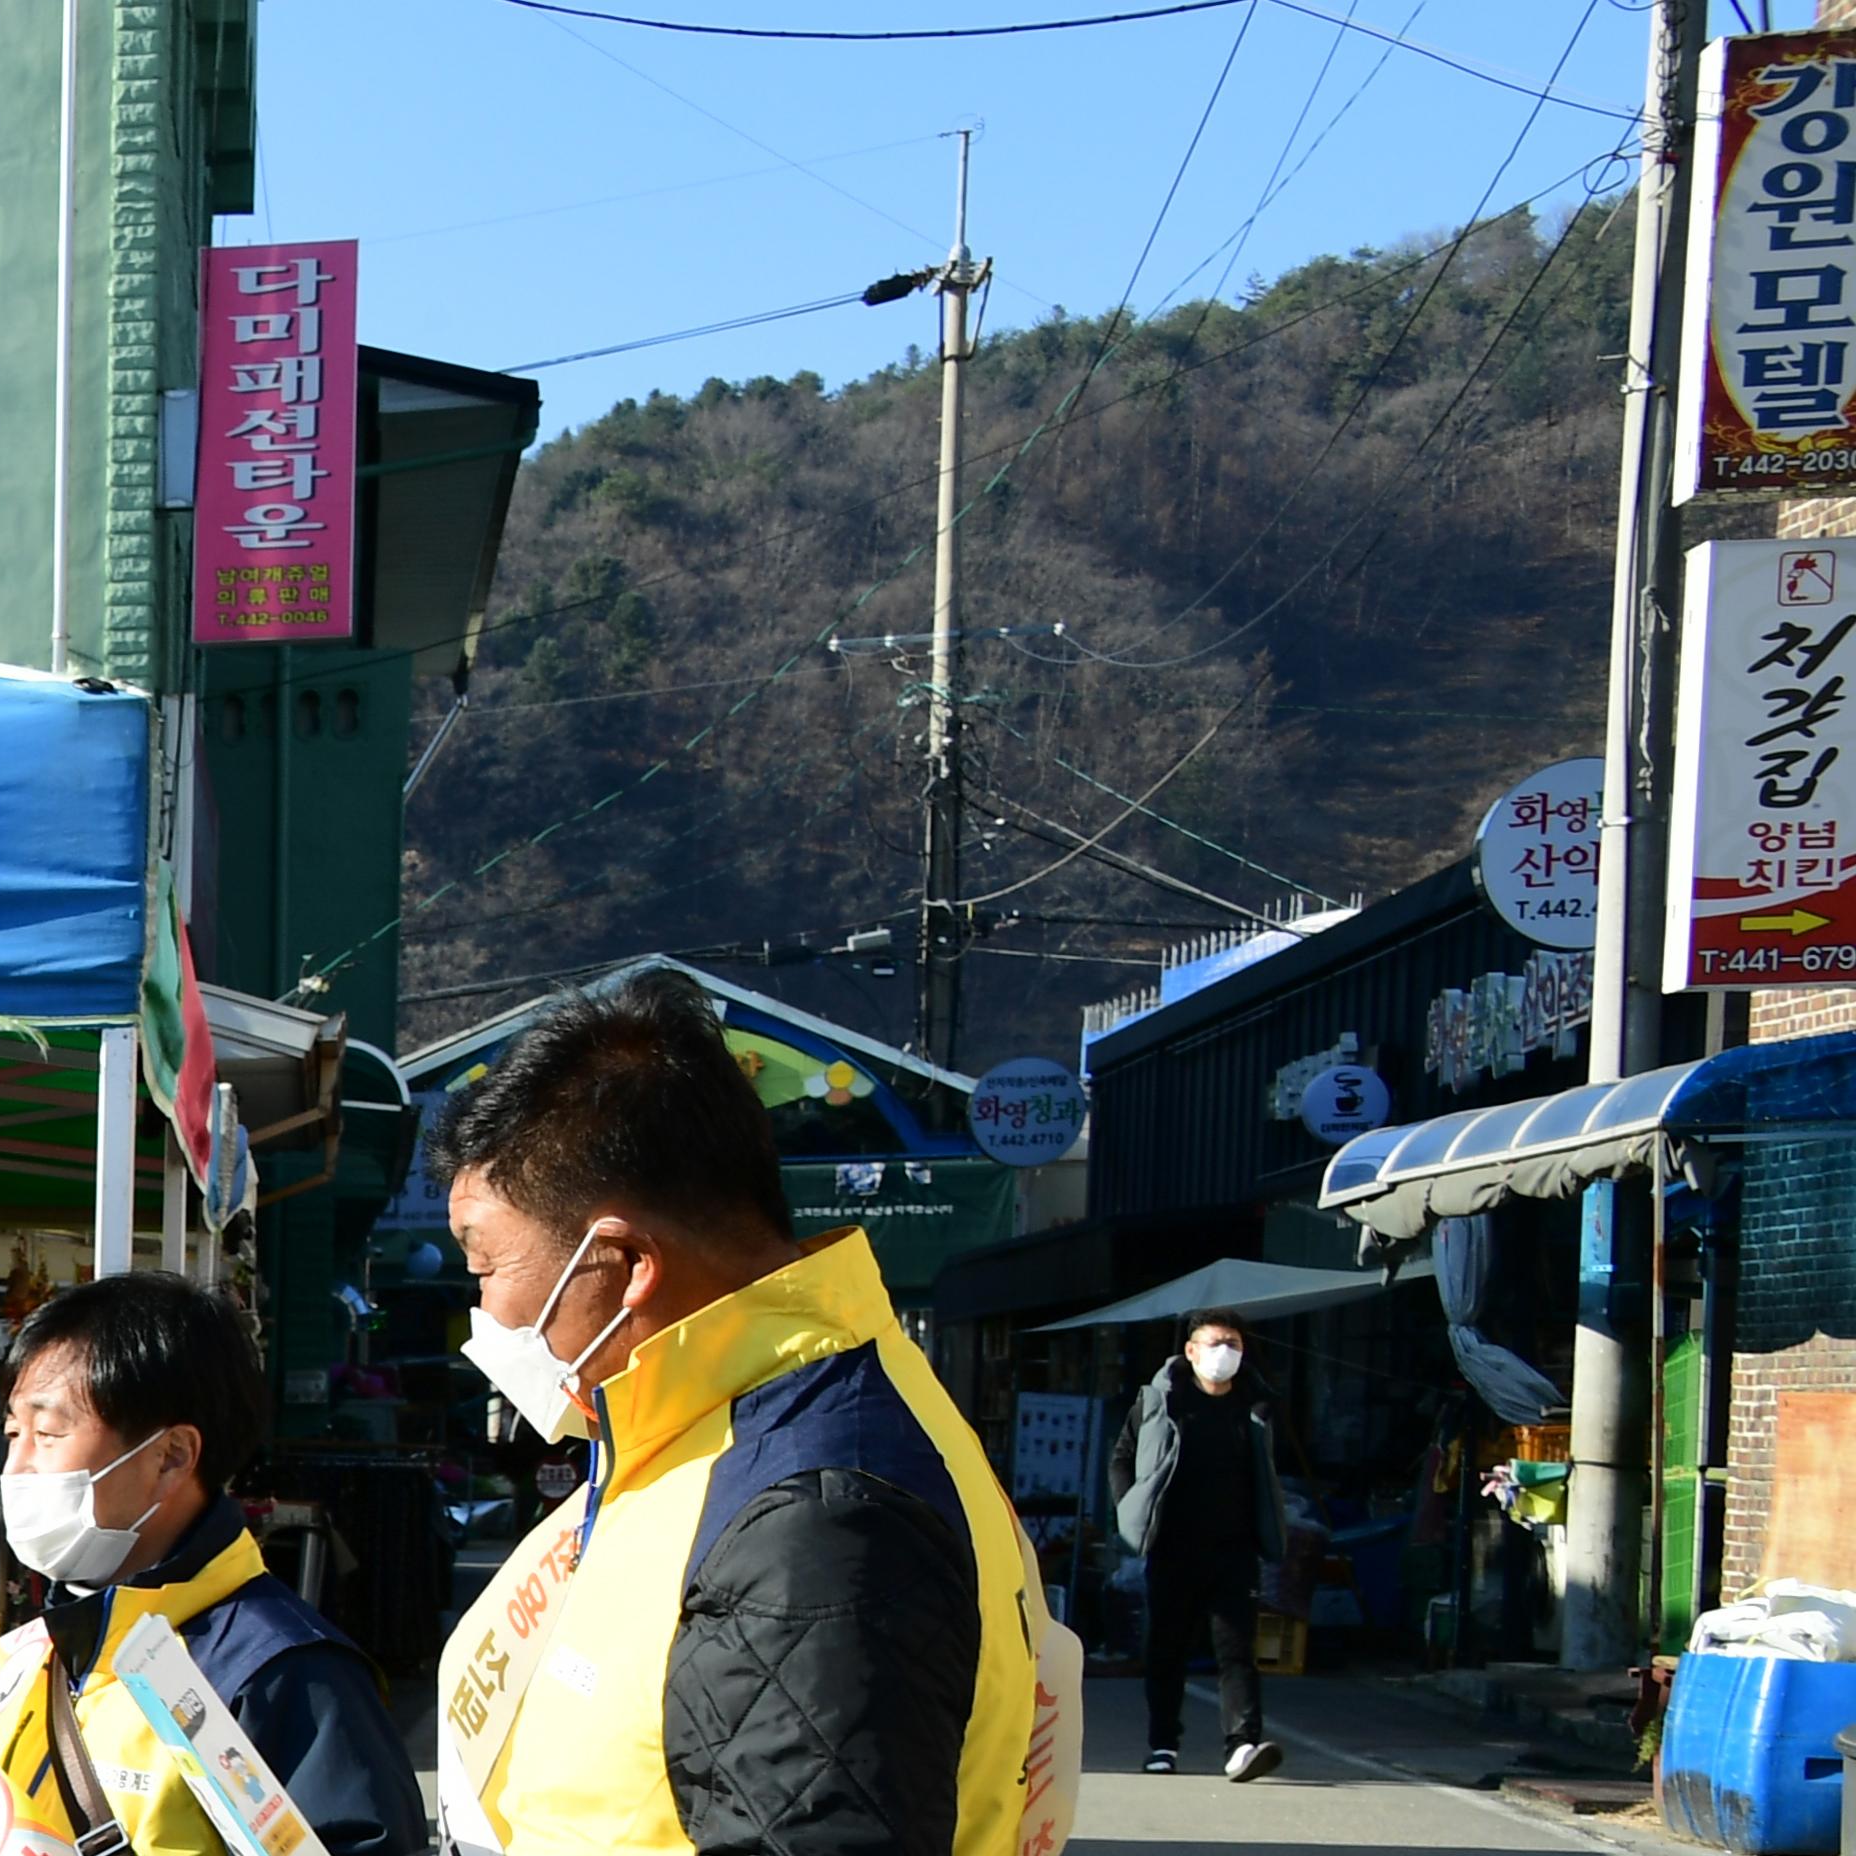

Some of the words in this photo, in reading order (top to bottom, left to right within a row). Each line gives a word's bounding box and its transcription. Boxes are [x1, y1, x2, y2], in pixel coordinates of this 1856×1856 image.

[1745, 614, 1856, 809] 처갓집
[1748, 822, 1837, 851] 양념
[1746, 858, 1836, 887] 치킨
[974, 1094, 1080, 1129] 화영청과
